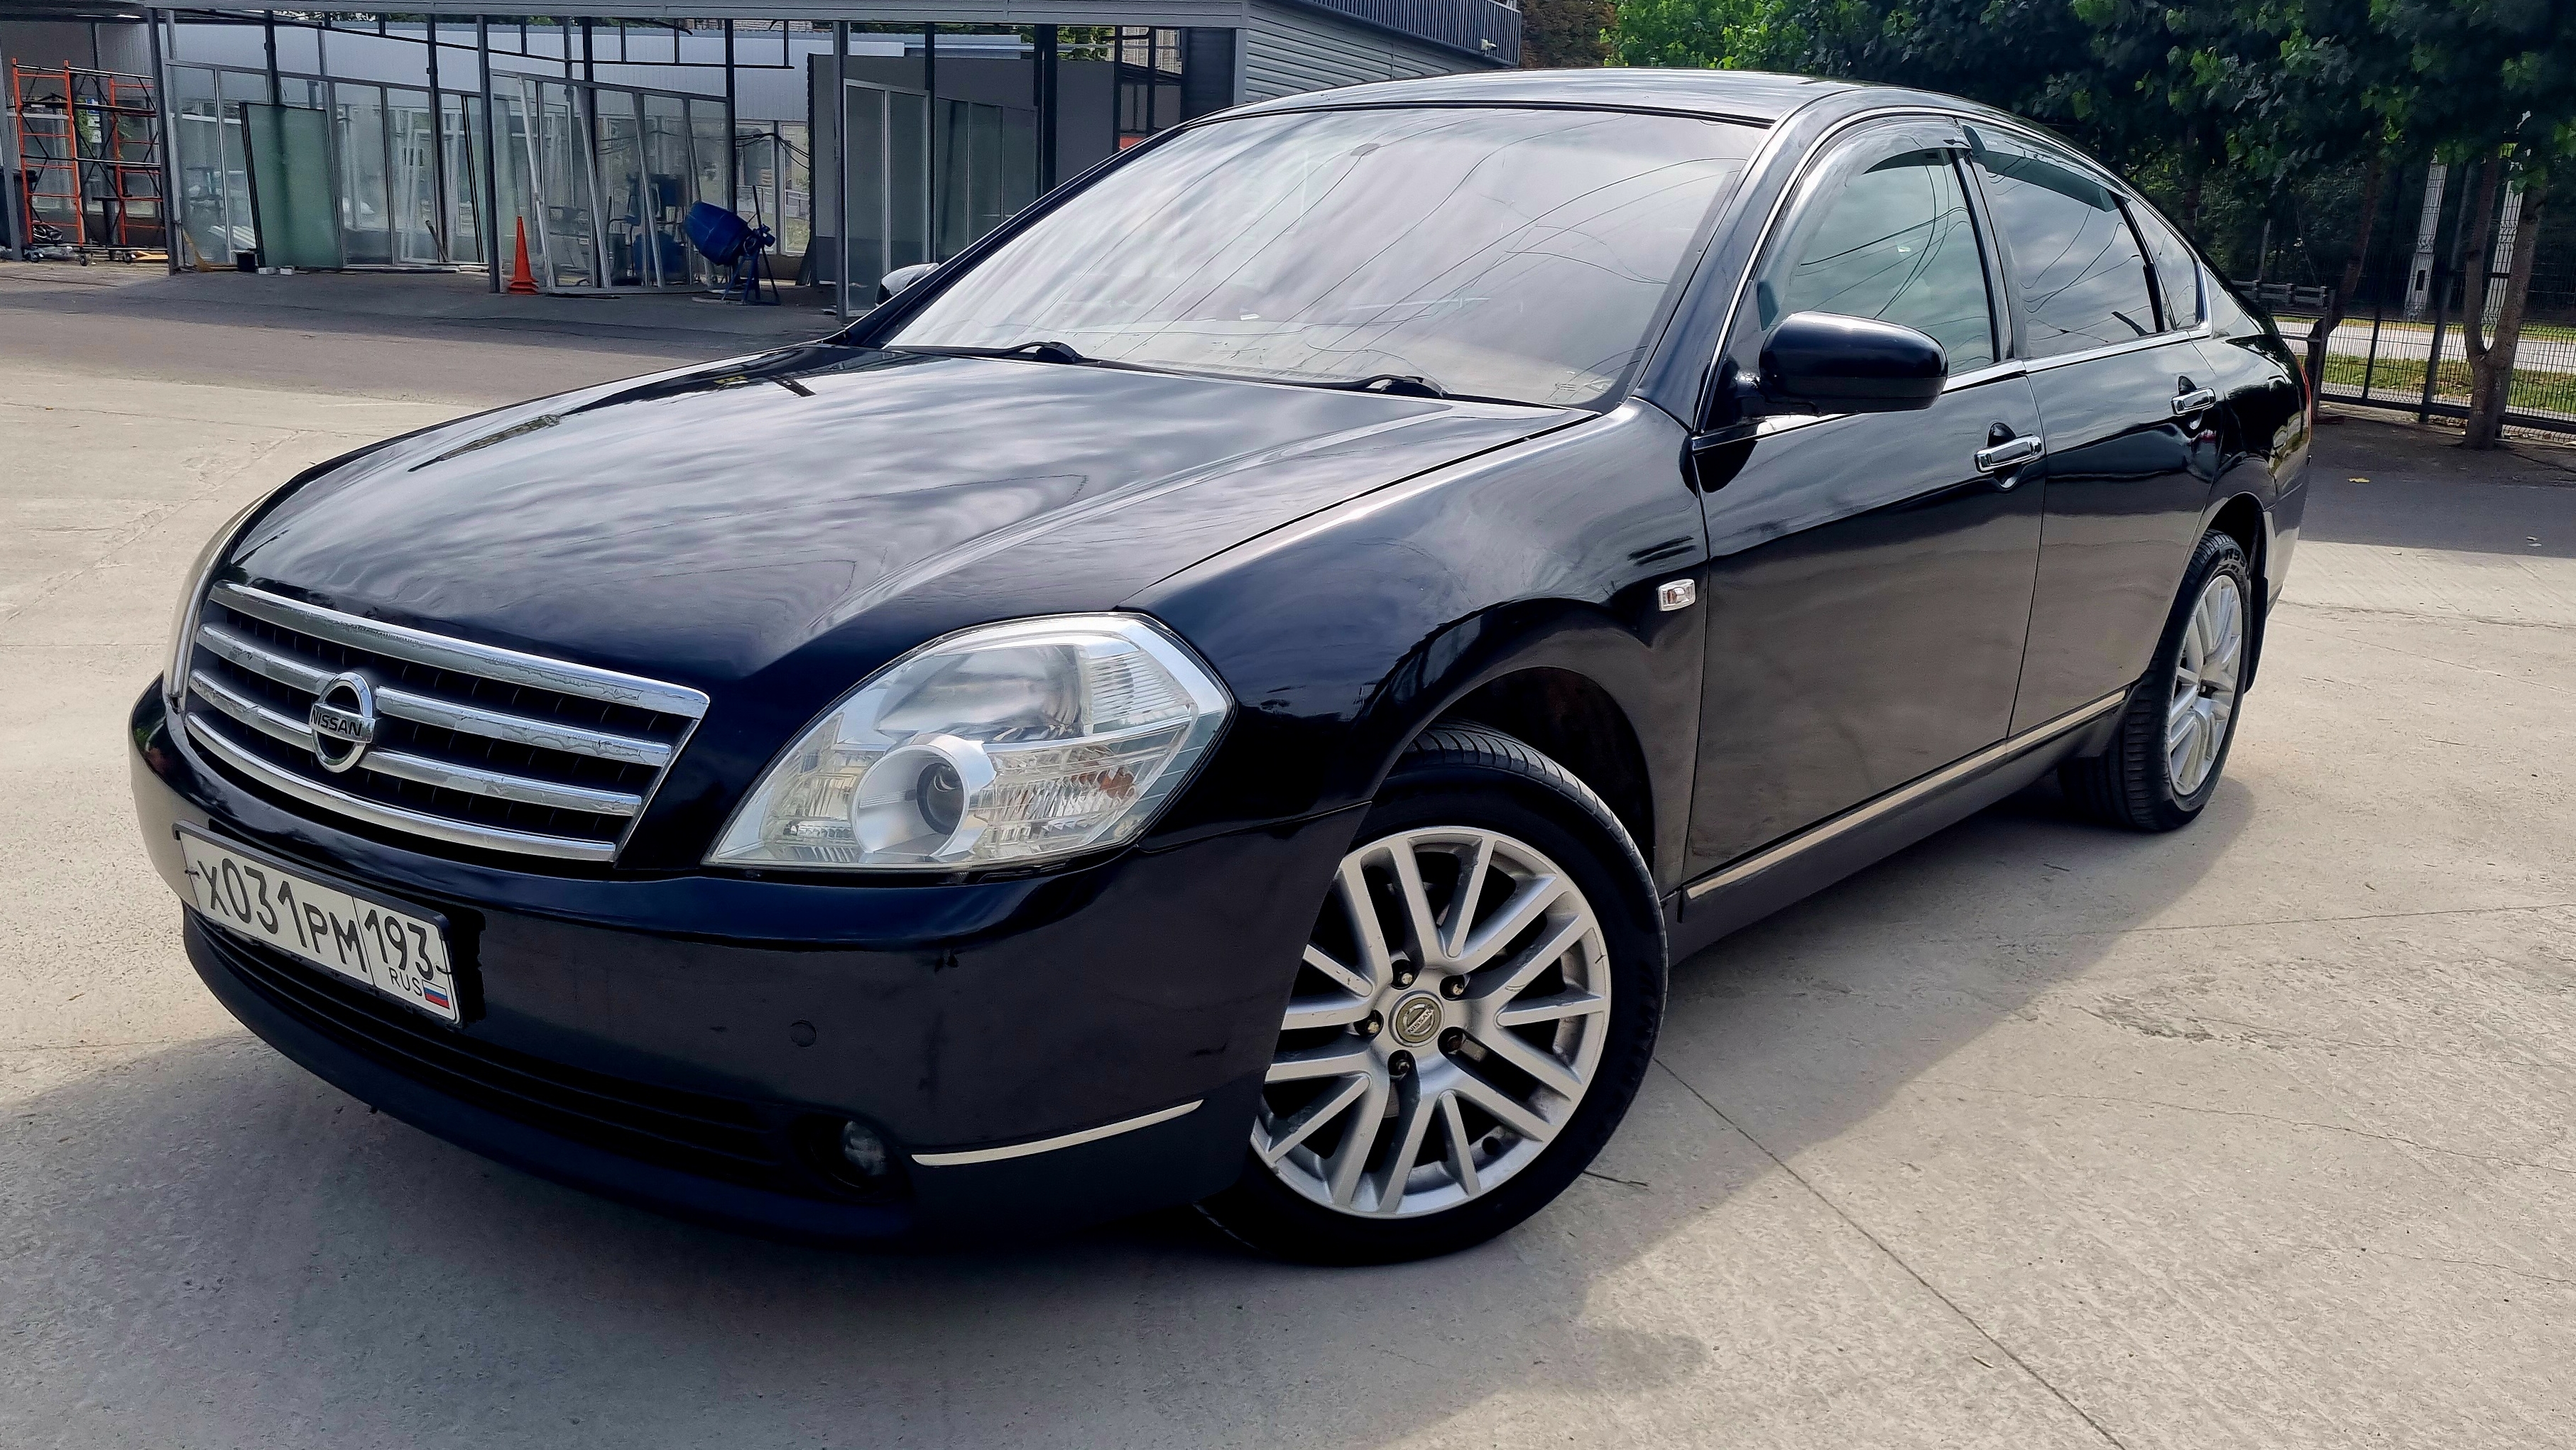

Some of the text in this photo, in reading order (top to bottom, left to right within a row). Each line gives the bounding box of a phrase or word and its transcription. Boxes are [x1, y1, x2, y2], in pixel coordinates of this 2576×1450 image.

[311, 709, 363, 736] NISSAN
[364, 909, 434, 981] 193
[391, 966, 423, 997] RUS
[1407, 1005, 1434, 1033] NISSAN
